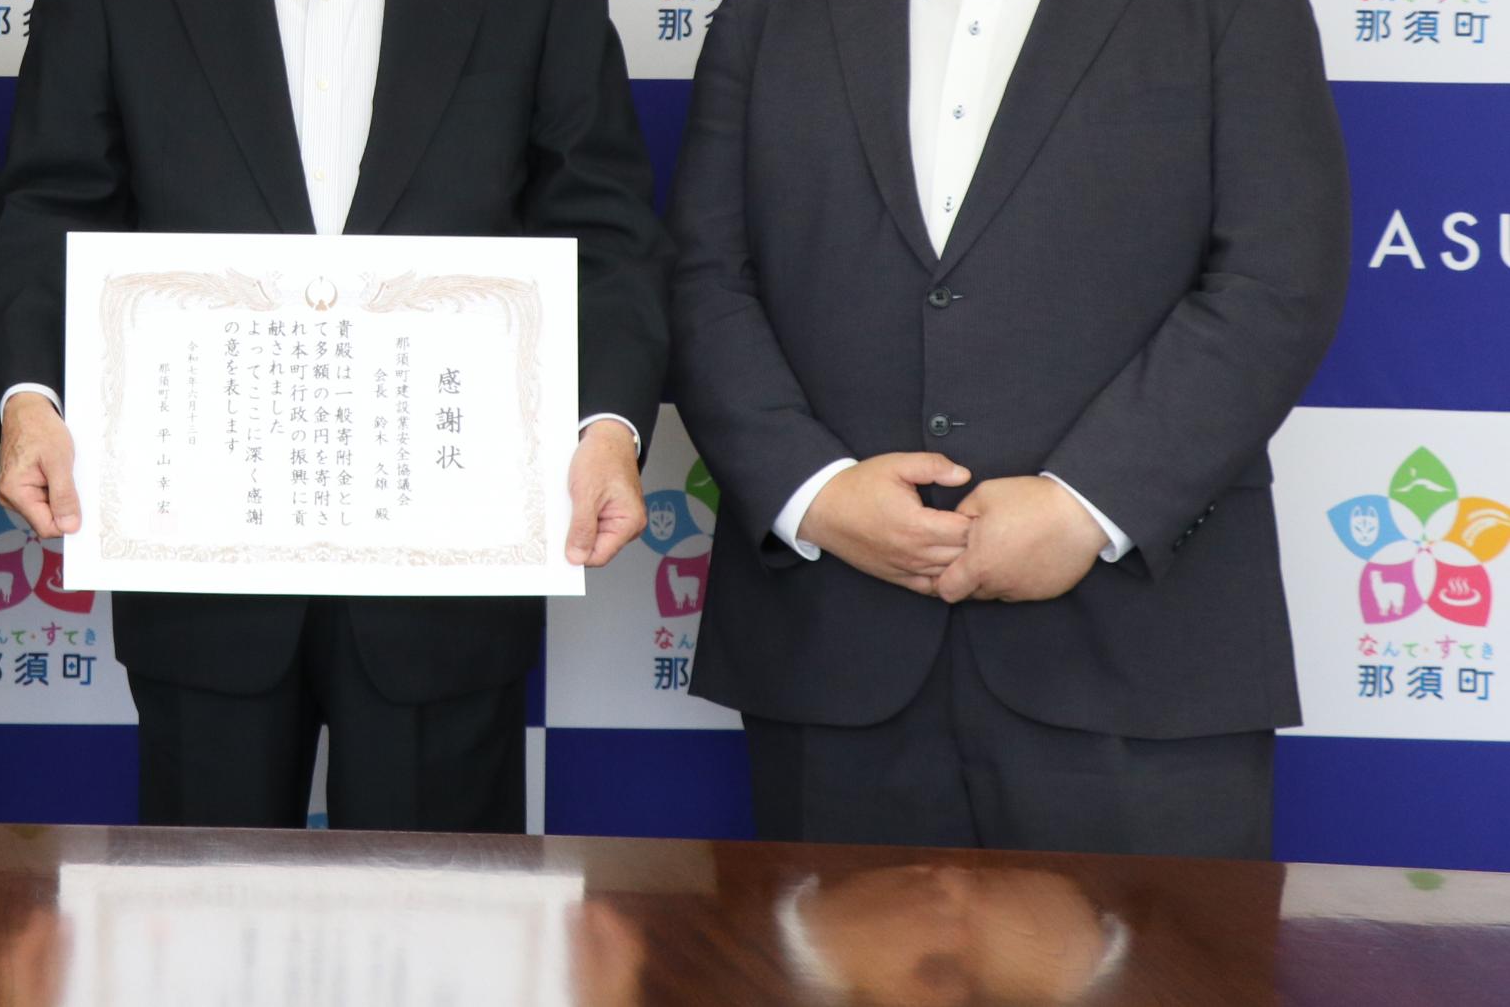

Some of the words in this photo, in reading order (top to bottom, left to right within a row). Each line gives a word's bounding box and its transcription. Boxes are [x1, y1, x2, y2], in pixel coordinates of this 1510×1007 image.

[1355, 9, 1491, 45] 那須町
[1368, 208, 1510, 272] AS
[223, 321, 240, 452] の意を表します
[245, 321, 264, 525] よってここに深く感謝
[268, 320, 286, 434] 献されました
[335, 319, 353, 526] 貴殿は一般寄附金とし
[373, 368, 388, 399] 会長
[435, 367, 465, 470] 感謝状
[1357, 664, 1495, 701] 那須町
